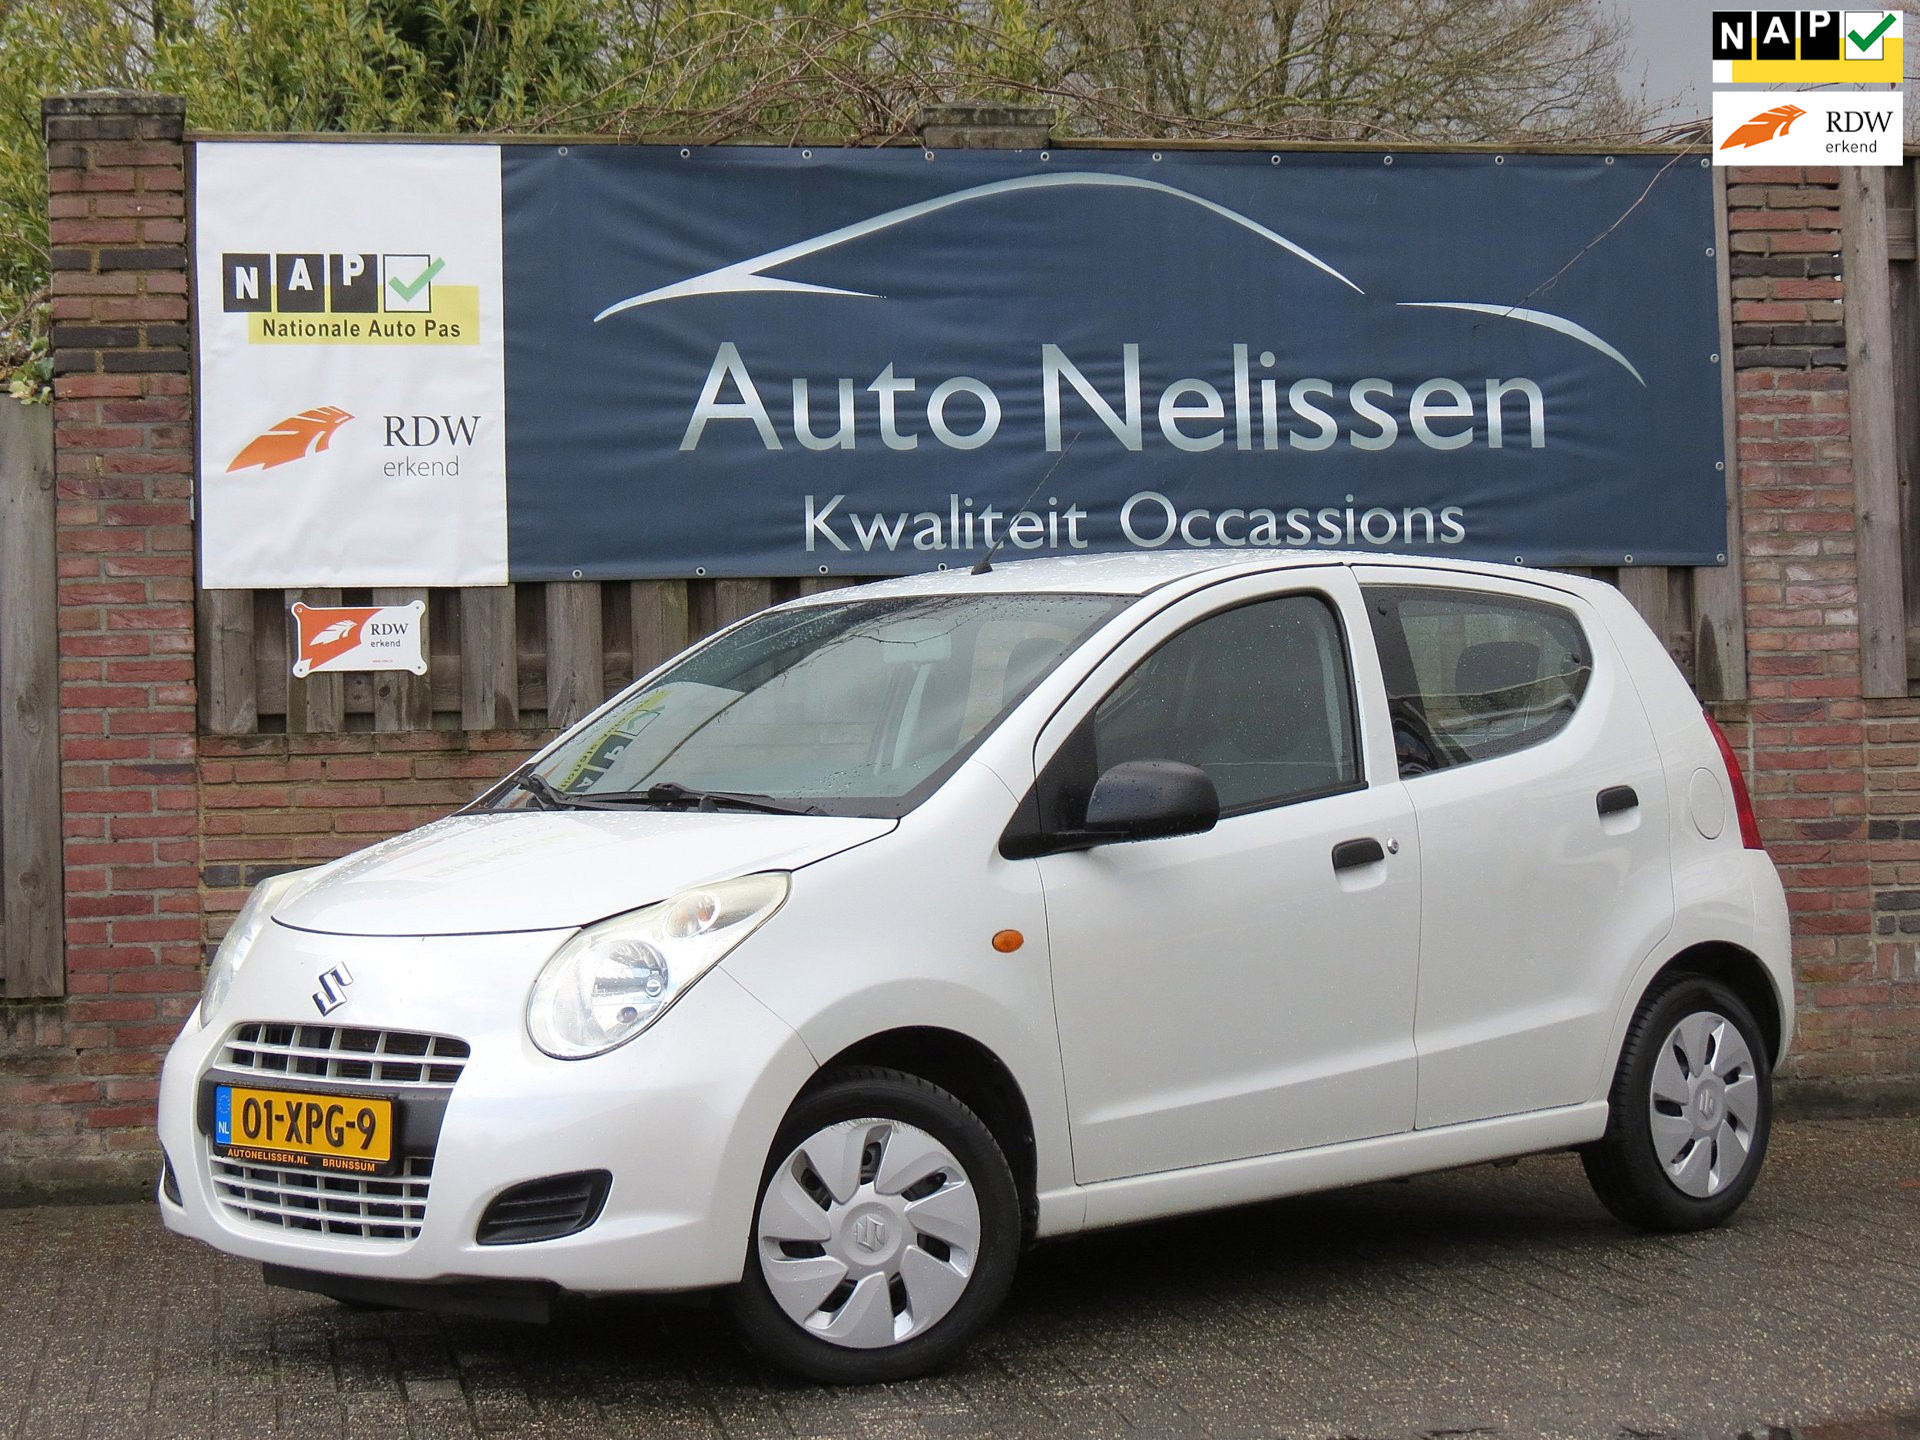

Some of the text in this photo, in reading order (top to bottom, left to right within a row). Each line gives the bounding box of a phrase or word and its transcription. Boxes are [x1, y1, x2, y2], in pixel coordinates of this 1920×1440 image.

[235, 254, 366, 300] NAP
[262, 319, 461, 338] Nationale Auto Pas
[679, 342, 1546, 453] Auto Nelissen
[383, 415, 481, 447] RDW
[383, 456, 459, 477] erkend
[804, 491, 1466, 552] Kwaliteit Occassions
[370, 623, 409, 636] RDW
[370, 639, 401, 648] erkend
[218, 1120, 230, 1135] NL
[242, 1097, 376, 1150] 01-XPG-9
[227, 1149, 376, 1172] AUTONELISSEN.NL BRUNSSUM
